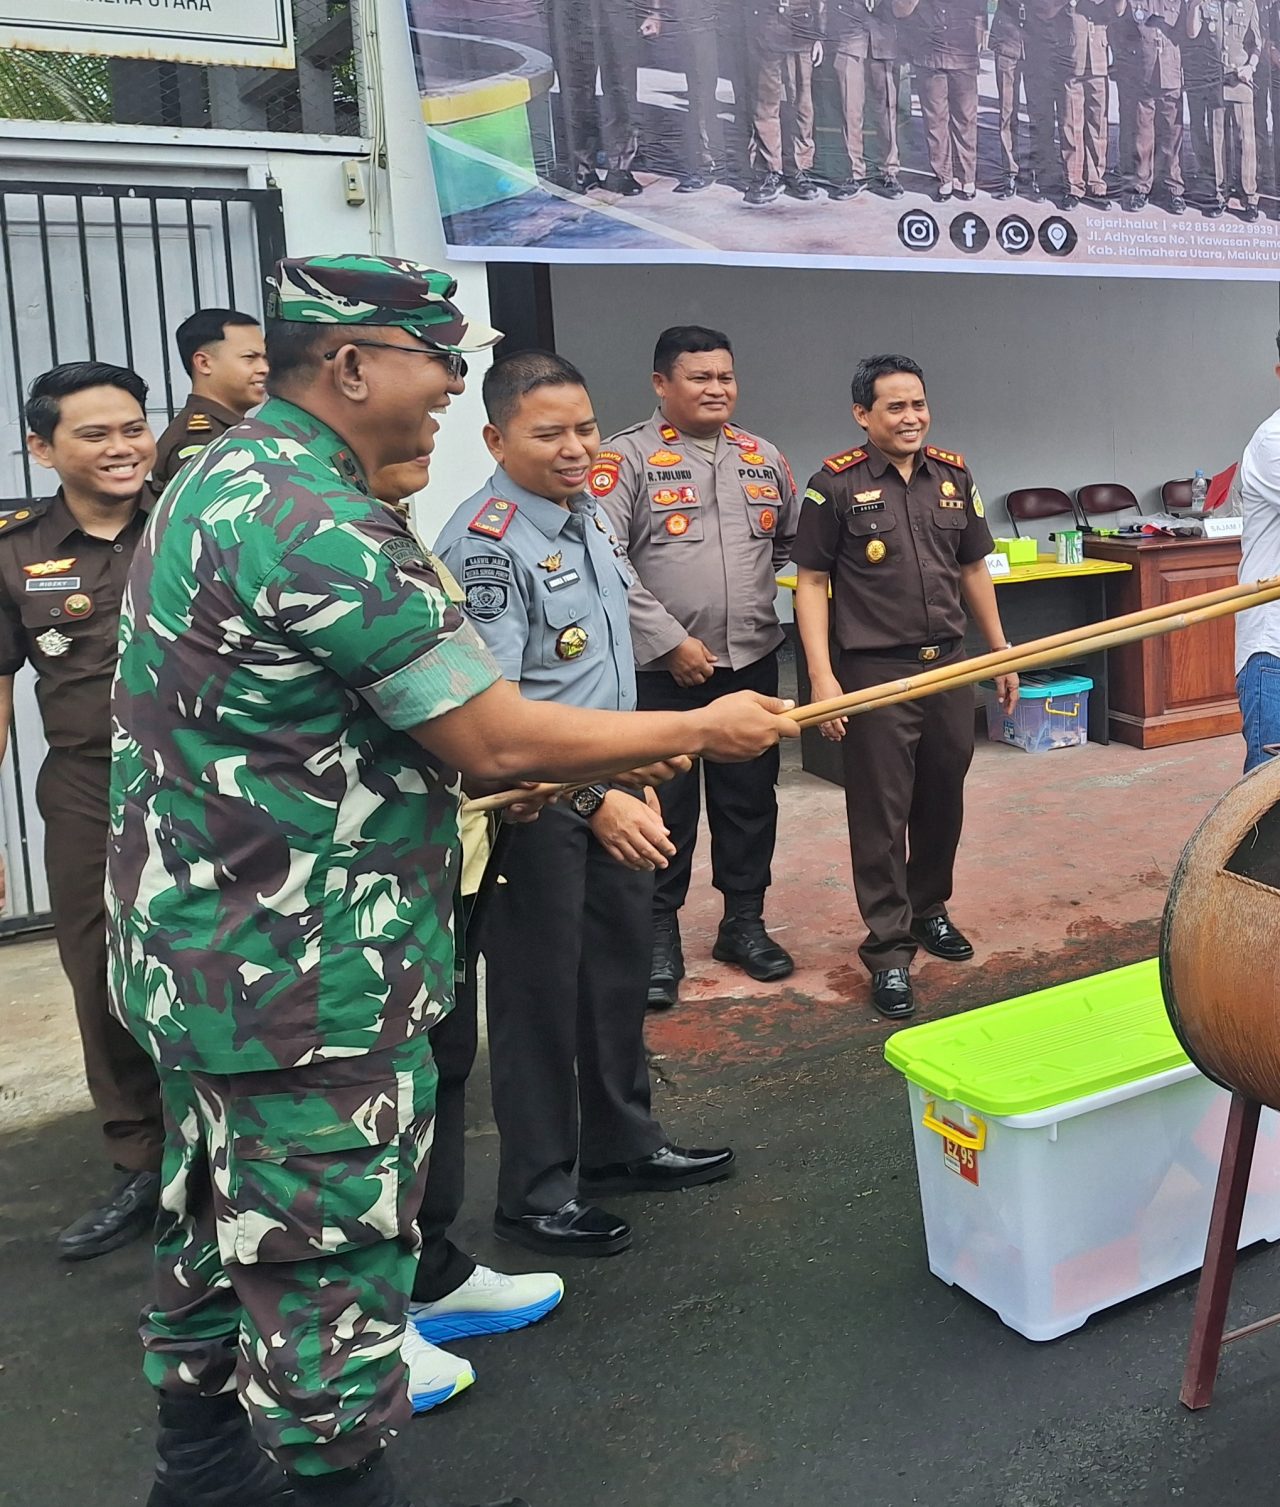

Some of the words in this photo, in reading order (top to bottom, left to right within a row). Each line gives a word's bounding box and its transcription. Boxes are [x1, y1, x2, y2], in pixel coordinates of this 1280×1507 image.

[1086, 217, 1158, 231] kejari.halut
[1171, 223, 1192, 232] +62
[1195, 223, 1216, 232] 853
[1219, 224, 1245, 233] 4222
[1247, 225, 1273, 235] 9939
[1087, 231, 1101, 241] Jl.
[1104, 231, 1166, 244] Adhyaksa
[1169, 235, 1188, 244] No.
[1198, 236, 1250, 247] Kawasan
[1087, 245, 1117, 256] Kab.
[1120, 246, 1187, 258] Halmahera
[1190, 248, 1225, 260] Utara,
[1228, 250, 1270, 260] Maluku
[647, 470, 692, 482] R.TJULUKU
[738, 469, 774, 480] POLRI
